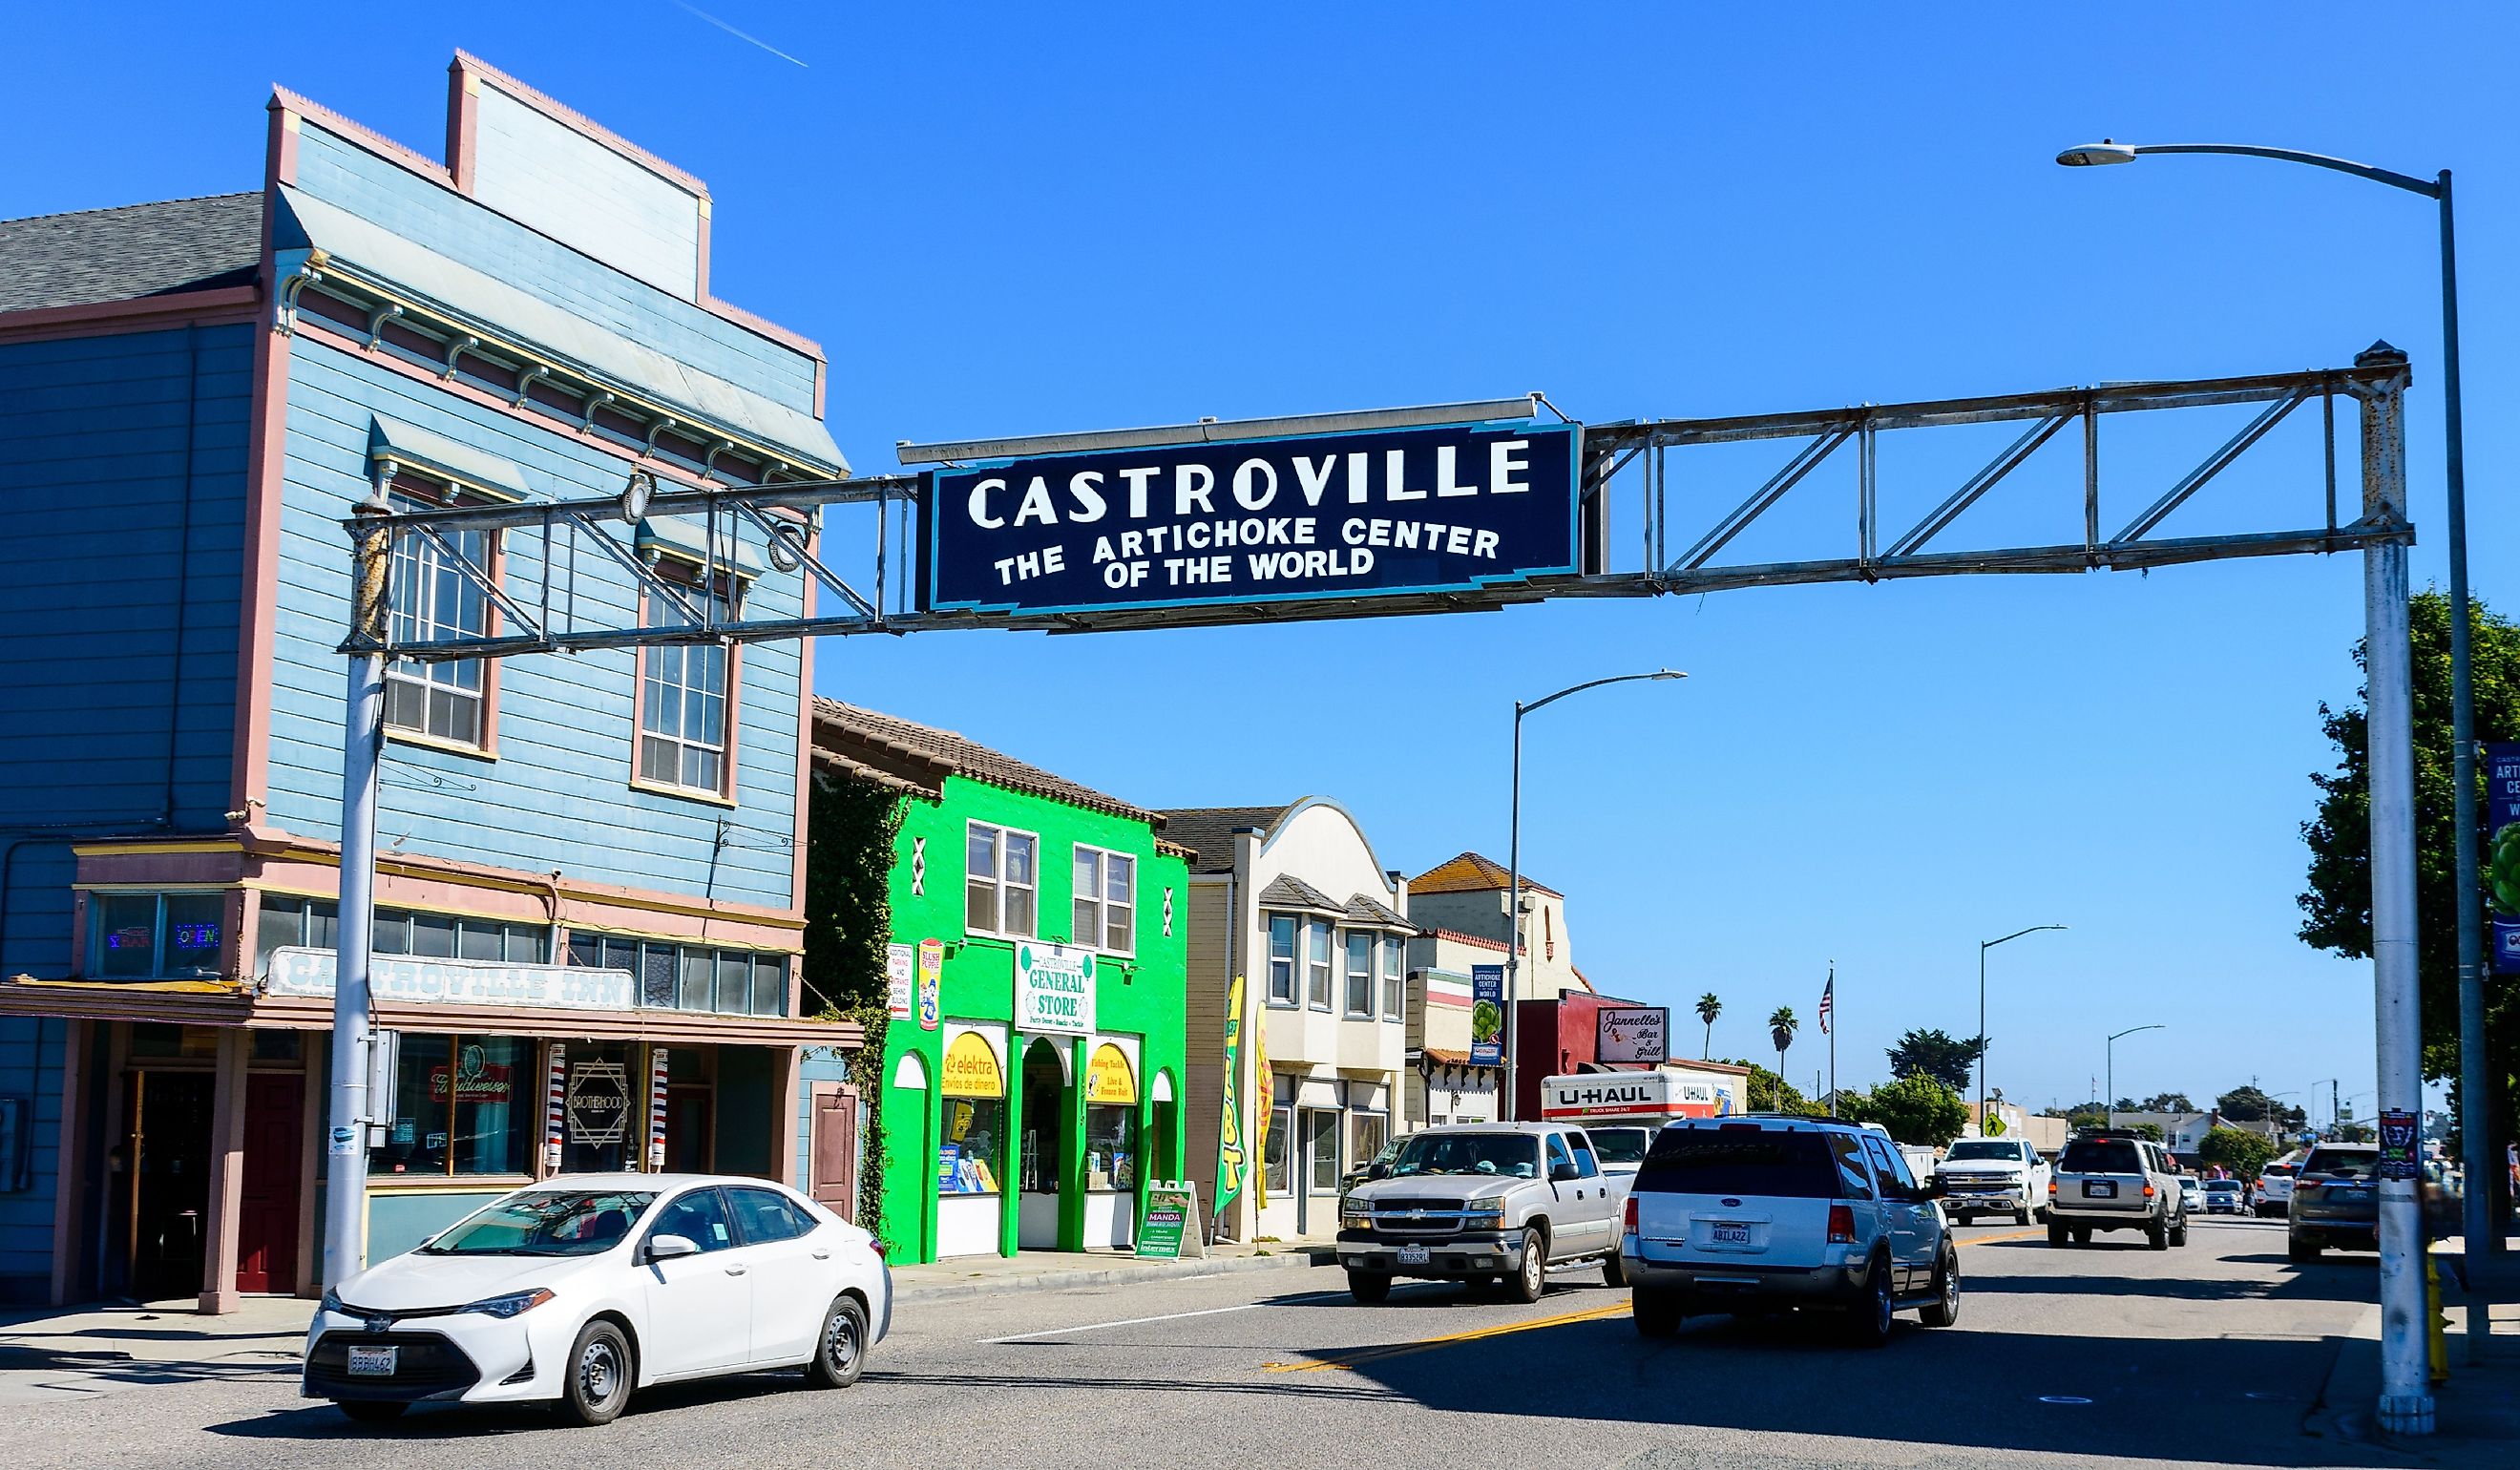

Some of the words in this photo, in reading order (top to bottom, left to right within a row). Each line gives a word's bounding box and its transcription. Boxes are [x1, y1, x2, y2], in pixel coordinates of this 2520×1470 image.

[968, 439, 1530, 529] CASTROVILLE
[995, 544, 1066, 586] THE
[1092, 517, 1317, 565] ARTICHOKE
[1341, 517, 1500, 559] CENTER
[1103, 560, 1151, 589] OF
[1164, 556, 1232, 585] THE
[1248, 547, 1376, 580] WORLD
[922, 951, 940, 961] SLUSH
[922, 959, 939, 969] PUPPIE
[1039, 956, 1077, 972] CASTROVILLE
[287, 955, 548, 998] CATROVILLE
[1029, 969, 1085, 993] GENERAL
[561, 973, 625, 1003] INN
[1038, 995, 1078, 1017] STORE
[1604, 1011, 1662, 1033] Jannelle's
[1636, 1028, 1659, 1040] Bar
[1645, 1039, 1653, 1047] &
[1634, 1046, 1662, 1060] Grill
[957, 1055, 993, 1075] elektra
[1091, 1059, 1108, 1070] Fishing
[1109, 1060, 1124, 1069] Tackle
[941, 1076, 962, 1089] Envíos
[964, 1078, 973, 1089] de
[974, 1078, 996, 1090] dinero
[1106, 1077, 1119, 1085] Live
[1118, 1078, 1123, 1086] &
[1101, 1086, 1117, 1096] Frozen
[1118, 1087, 1128, 1097] Bait
[1559, 1086, 1652, 1105] U-HAUL
[1684, 1085, 1709, 1101] U-HAUL
[573, 1095, 623, 1109] BROTHERHOOD
